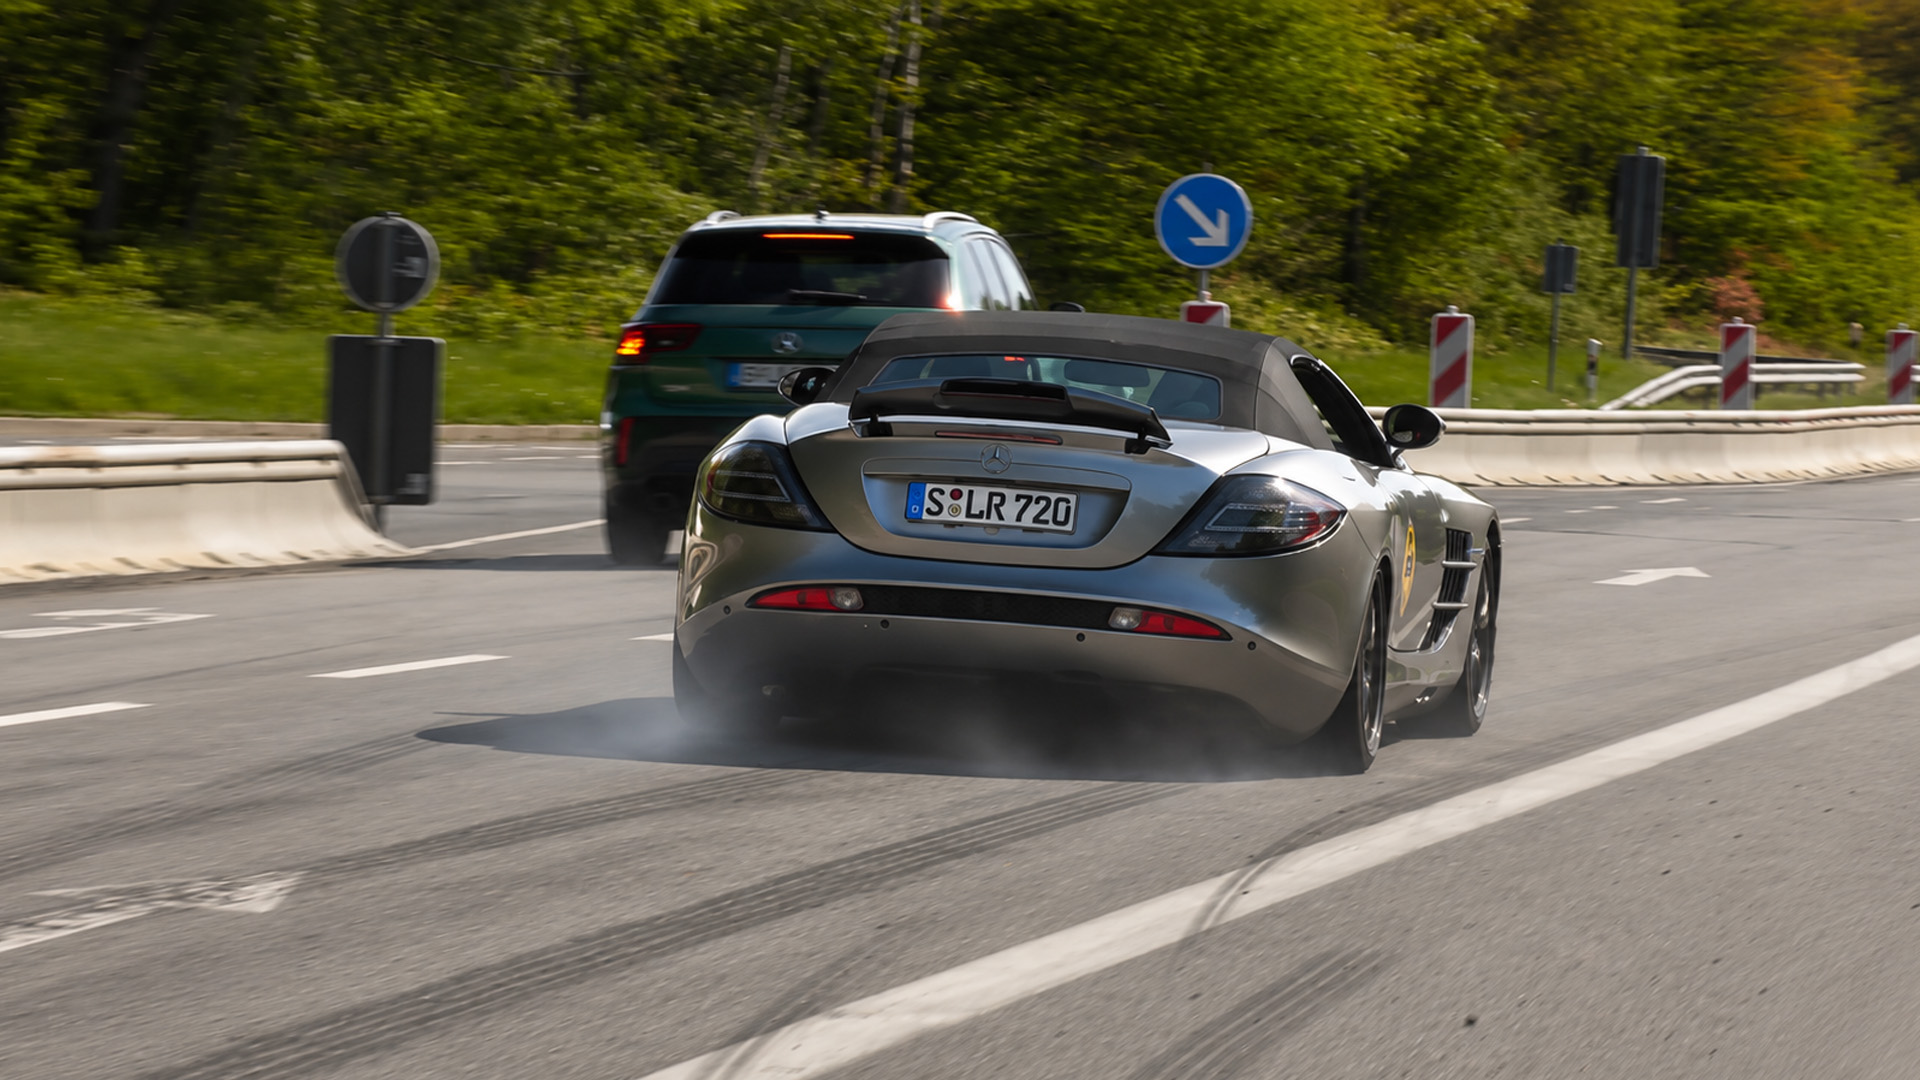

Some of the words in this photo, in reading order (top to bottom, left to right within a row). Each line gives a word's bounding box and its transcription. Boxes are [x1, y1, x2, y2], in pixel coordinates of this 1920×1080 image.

[925, 488, 945, 516] S
[965, 490, 1005, 521] LR
[1015, 494, 1071, 526] 720
